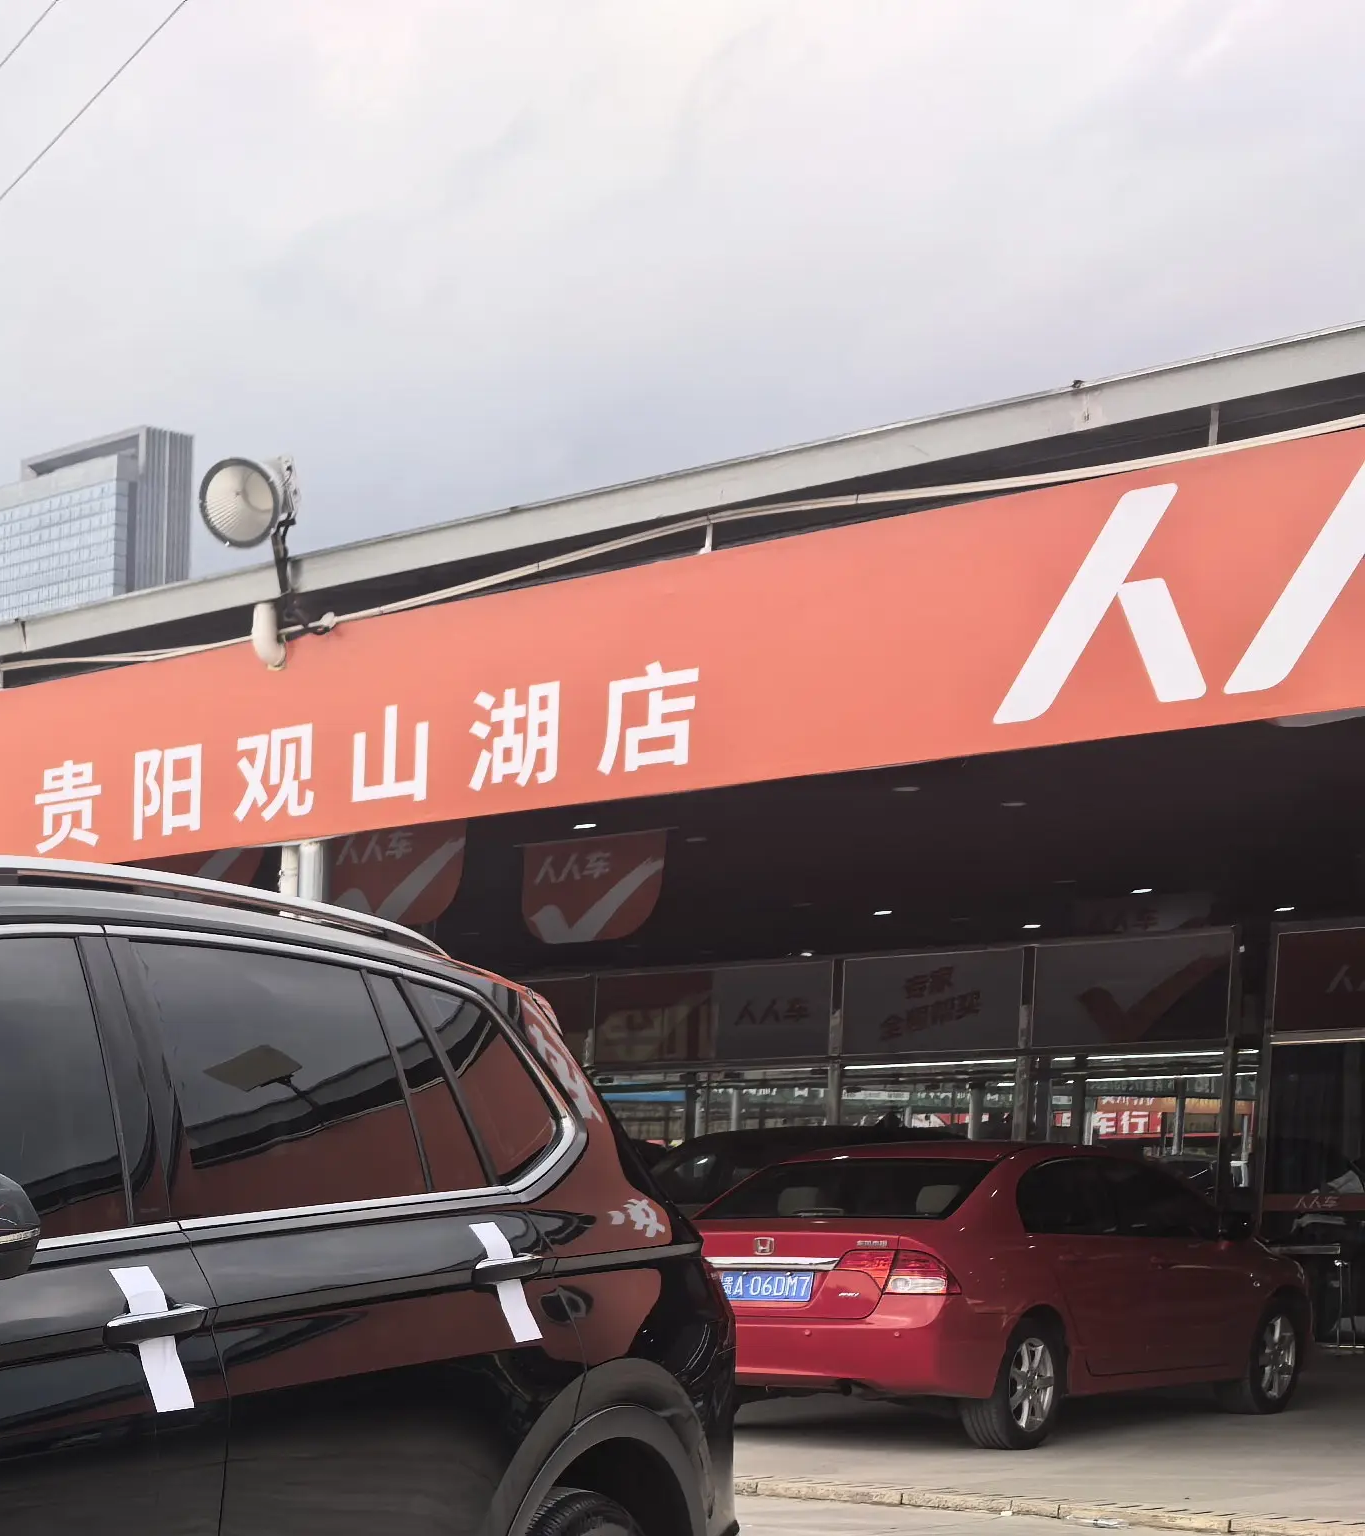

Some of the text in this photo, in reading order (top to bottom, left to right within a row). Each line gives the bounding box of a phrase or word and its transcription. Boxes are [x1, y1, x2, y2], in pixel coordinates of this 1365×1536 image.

[33, 660, 699, 855] 贵阳观山湖店
[336, 832, 413, 866] 人人车
[535, 852, 610, 886] 人人车
[735, 998, 811, 1027] 人人车
